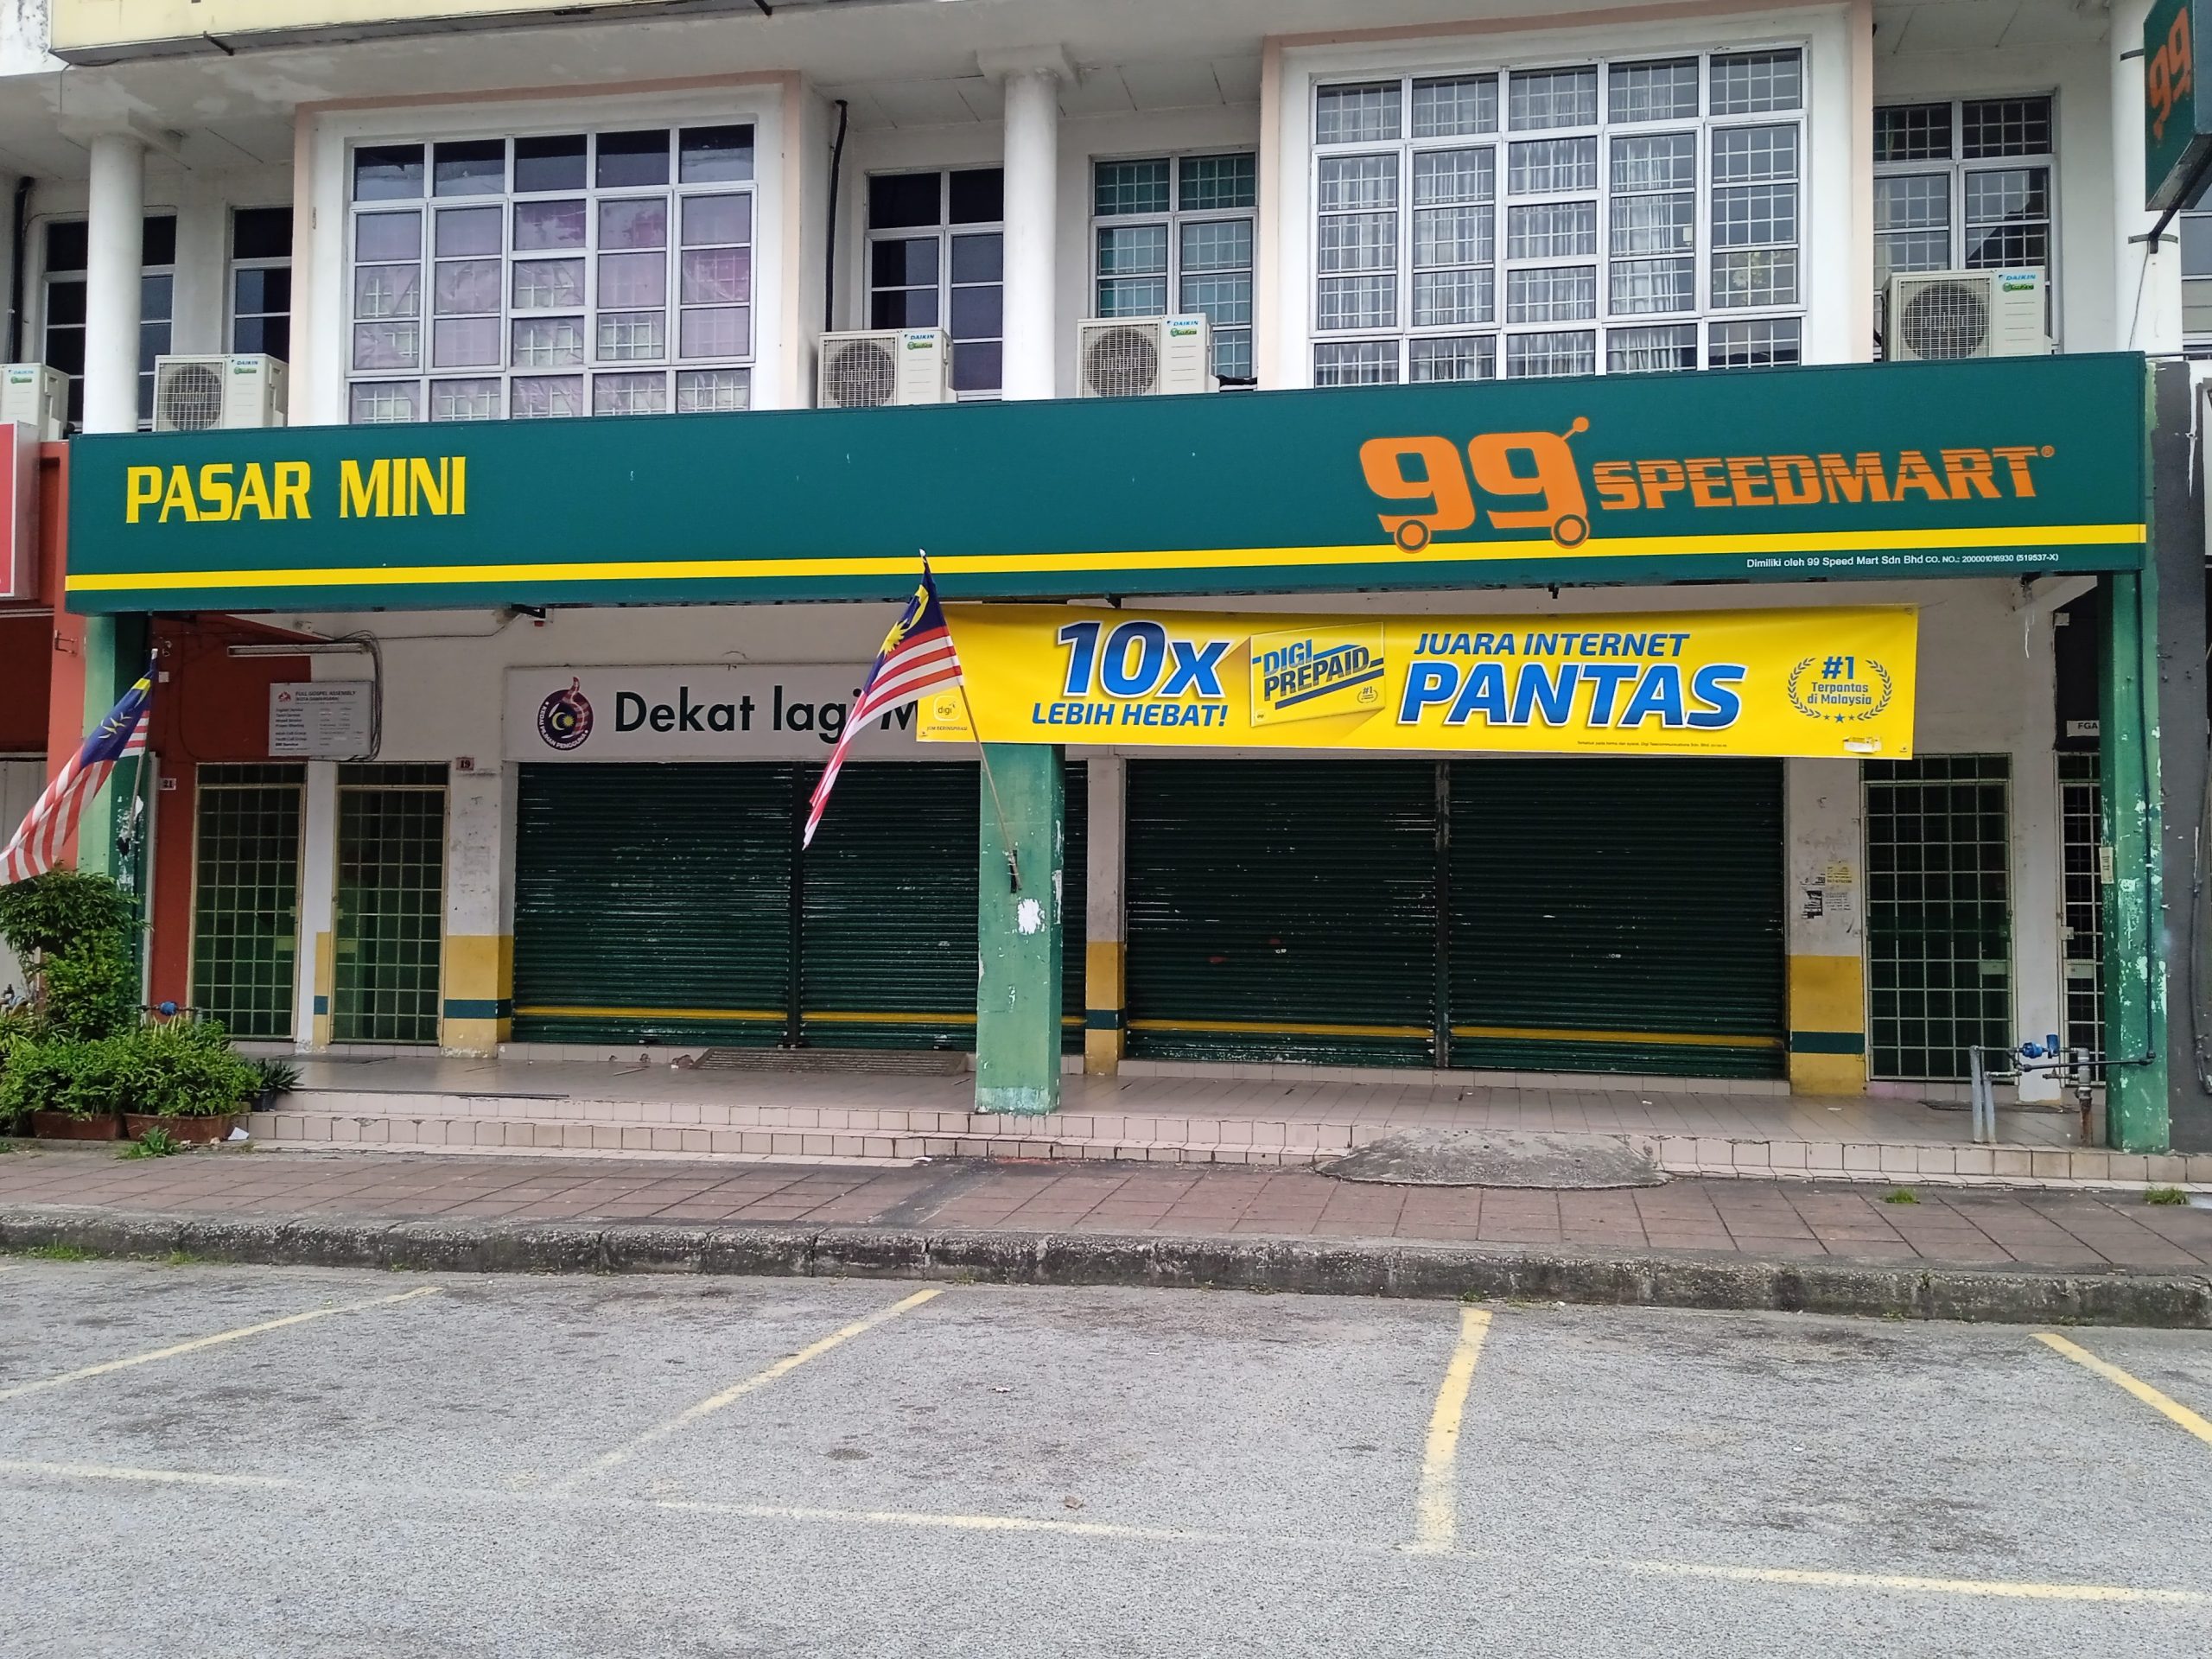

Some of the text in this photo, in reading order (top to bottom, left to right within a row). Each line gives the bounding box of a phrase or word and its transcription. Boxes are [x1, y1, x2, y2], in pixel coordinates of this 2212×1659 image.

[2149, 7, 2192, 140] 99
[126, 456, 467, 524] PASAR MINI
[1359, 417, 2039, 553] 99 SPEEDMART
[1746, 558, 1782, 568] Dimiliki
[1783, 557, 1805, 567] oleh
[1807, 557, 1820, 566] 99
[1822, 556, 1853, 568] Speed
[1856, 556, 1878, 565] Mart
[1881, 555, 1901, 564] Sdn
[1904, 555, 1923, 563] Bhd
[2016, 553, 2059, 562] (519537-X)
[1414, 632, 1690, 657] JUARA INTERNET
[1263, 639, 1313, 677] DIGI
[1821, 656, 1855, 680] #1
[1264, 646, 1370, 702] PREPAID
[1396, 661, 1749, 731] PANTAS
[1807, 693, 1872, 706] di Malaysia
[1811, 682, 1869, 695] Terpantas
[615, 686, 755, 732] Dekat
[938, 705, 952, 715] digi
[1032, 702, 1229, 727] LEBIH HEBAT!
[539, 725, 556, 746] PILIHAN
[556, 733, 588, 749] PENGGUNA
[2077, 721, 2098, 730] FGA
[461, 760, 471, 768] 19
